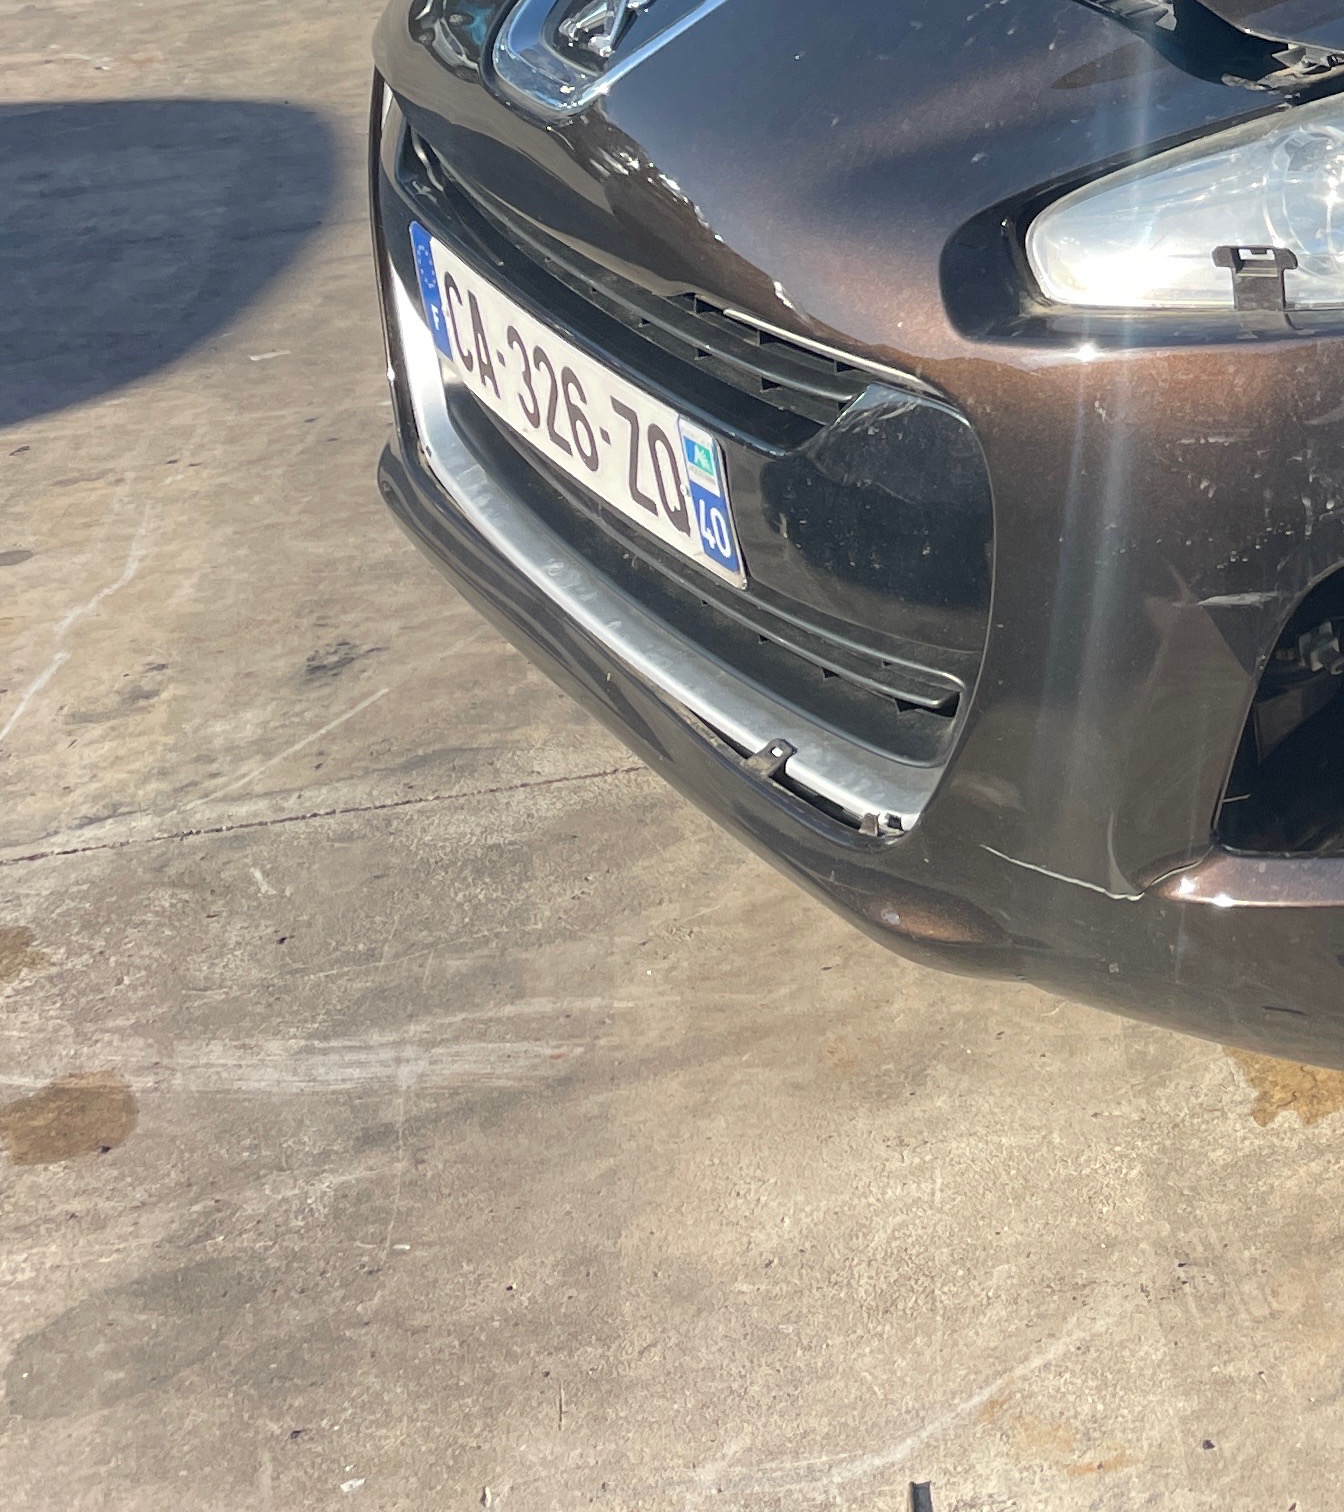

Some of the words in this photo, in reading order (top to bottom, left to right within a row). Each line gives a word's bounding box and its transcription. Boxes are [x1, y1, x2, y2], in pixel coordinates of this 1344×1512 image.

[430, 303, 441, 331] F
[444, 272, 691, 537] CA-326-ZQ
[699, 498, 731, 558] 40
